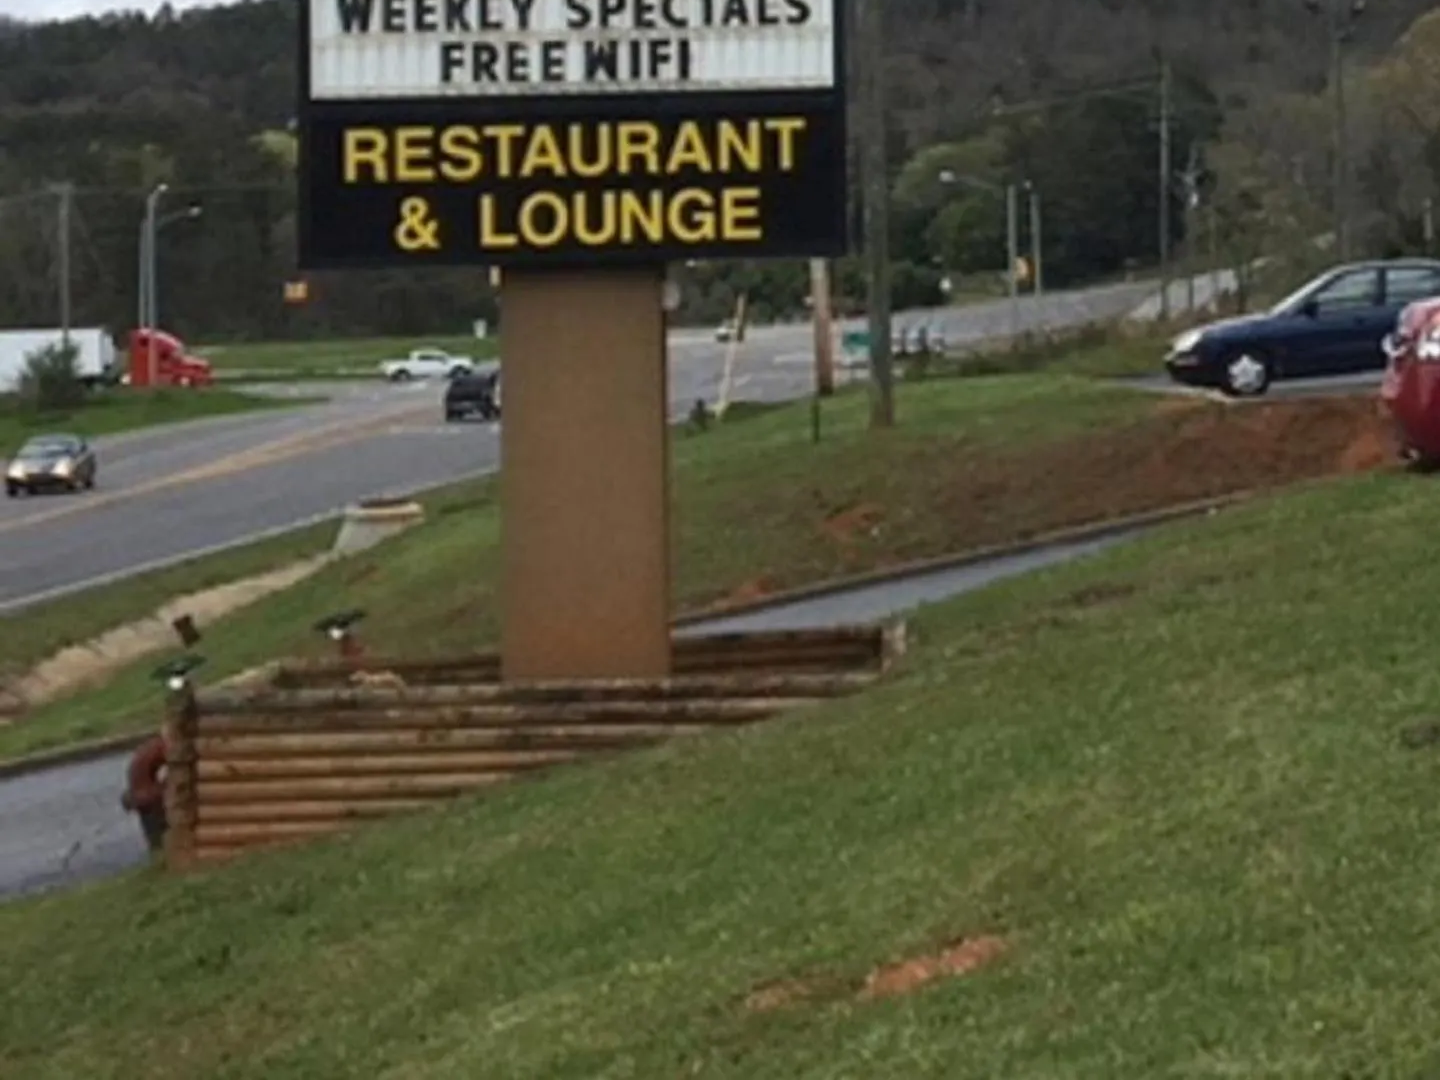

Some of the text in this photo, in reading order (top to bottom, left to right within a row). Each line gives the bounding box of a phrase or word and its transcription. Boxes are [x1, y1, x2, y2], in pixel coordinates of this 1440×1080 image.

[440, 38, 691, 84] FREE WIFI
[343, 119, 805, 182] RESTAURANT
[395, 187, 762, 249] & LOUNGE
